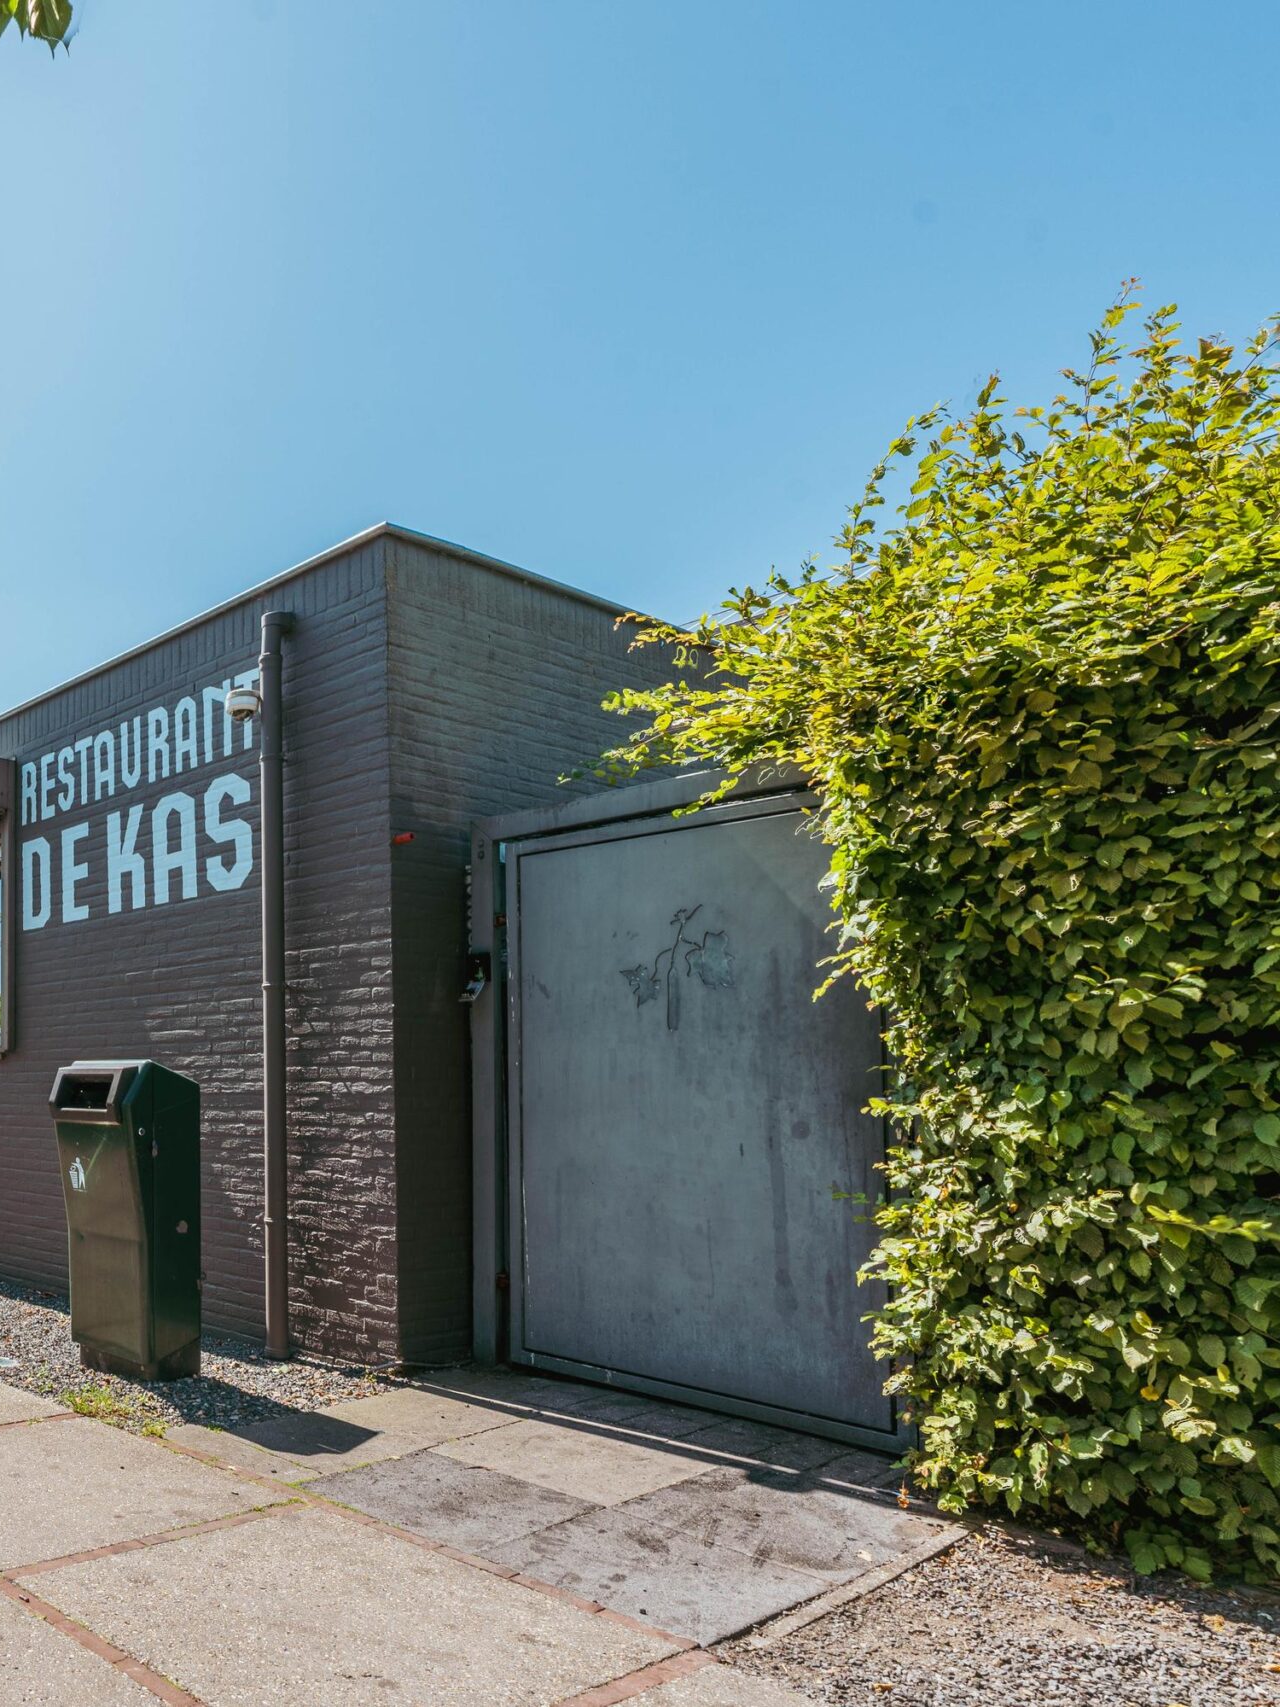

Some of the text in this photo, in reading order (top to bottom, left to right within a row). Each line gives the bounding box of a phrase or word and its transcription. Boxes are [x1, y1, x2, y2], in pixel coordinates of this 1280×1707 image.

[21, 667, 261, 826] RESTAURANT
[21, 772, 254, 931] DE KAS
